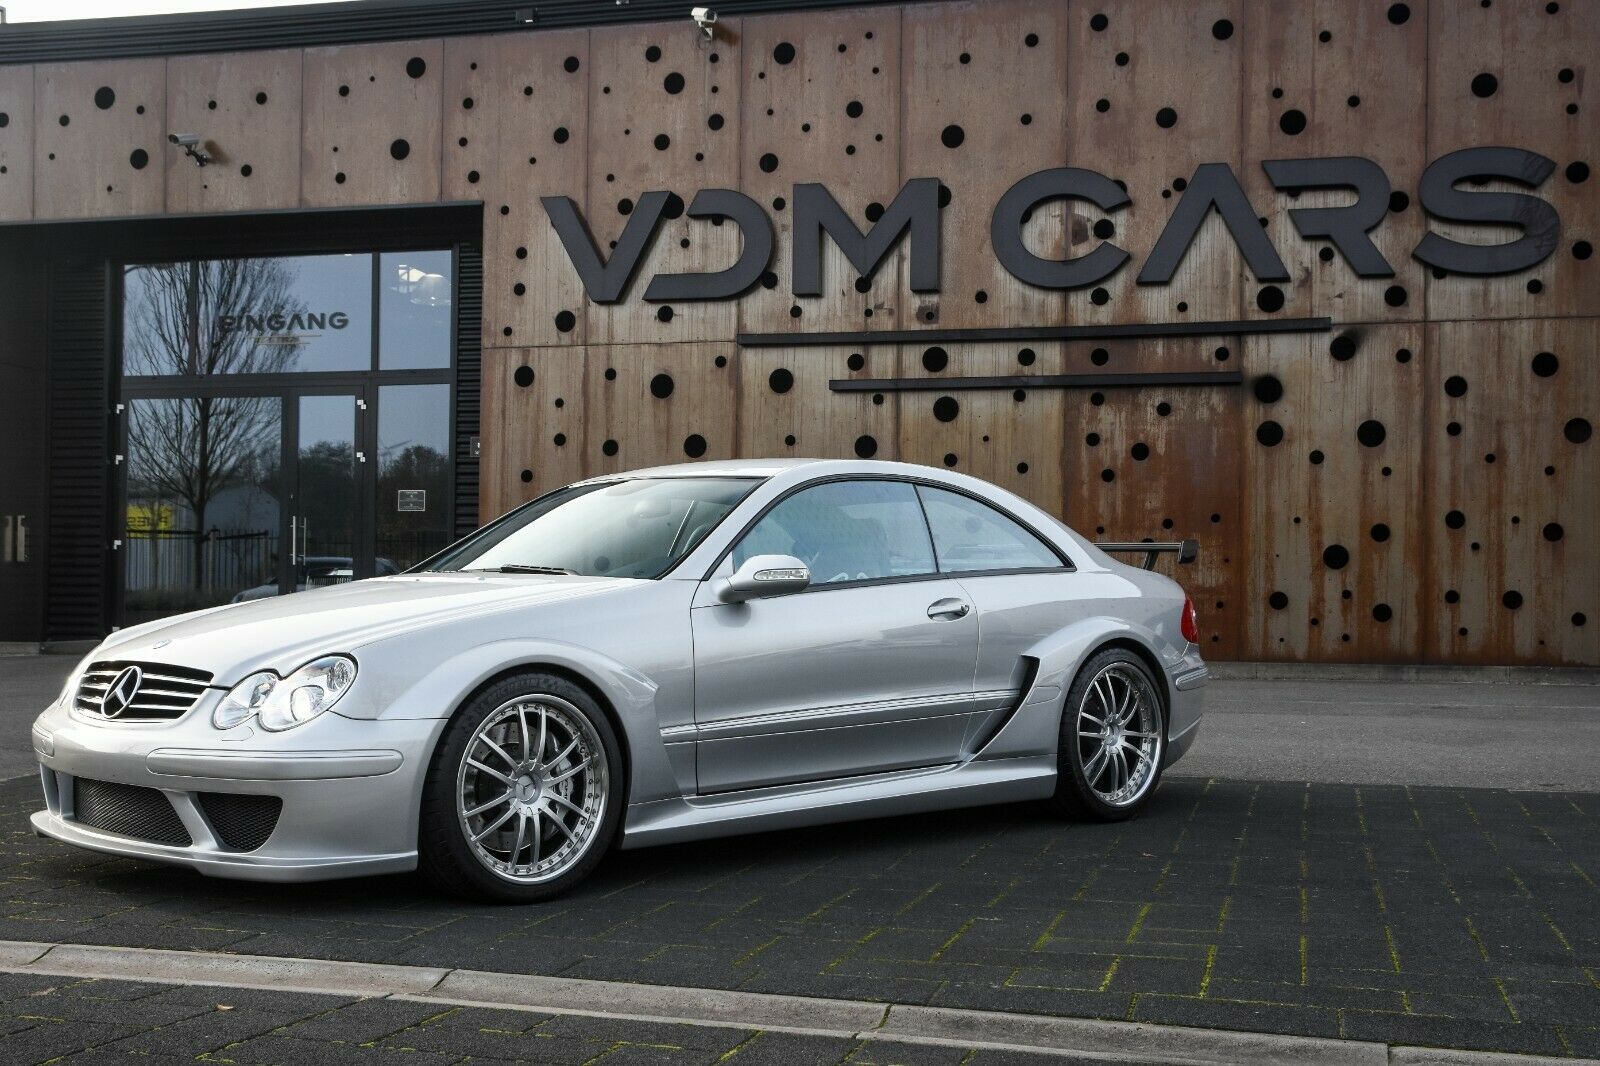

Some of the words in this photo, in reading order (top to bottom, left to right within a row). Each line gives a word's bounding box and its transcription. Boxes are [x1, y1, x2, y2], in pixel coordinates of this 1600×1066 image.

[540, 177, 941, 303] VDM
[990, 146, 1561, 289] CARS
[219, 311, 349, 332] EINGANG
